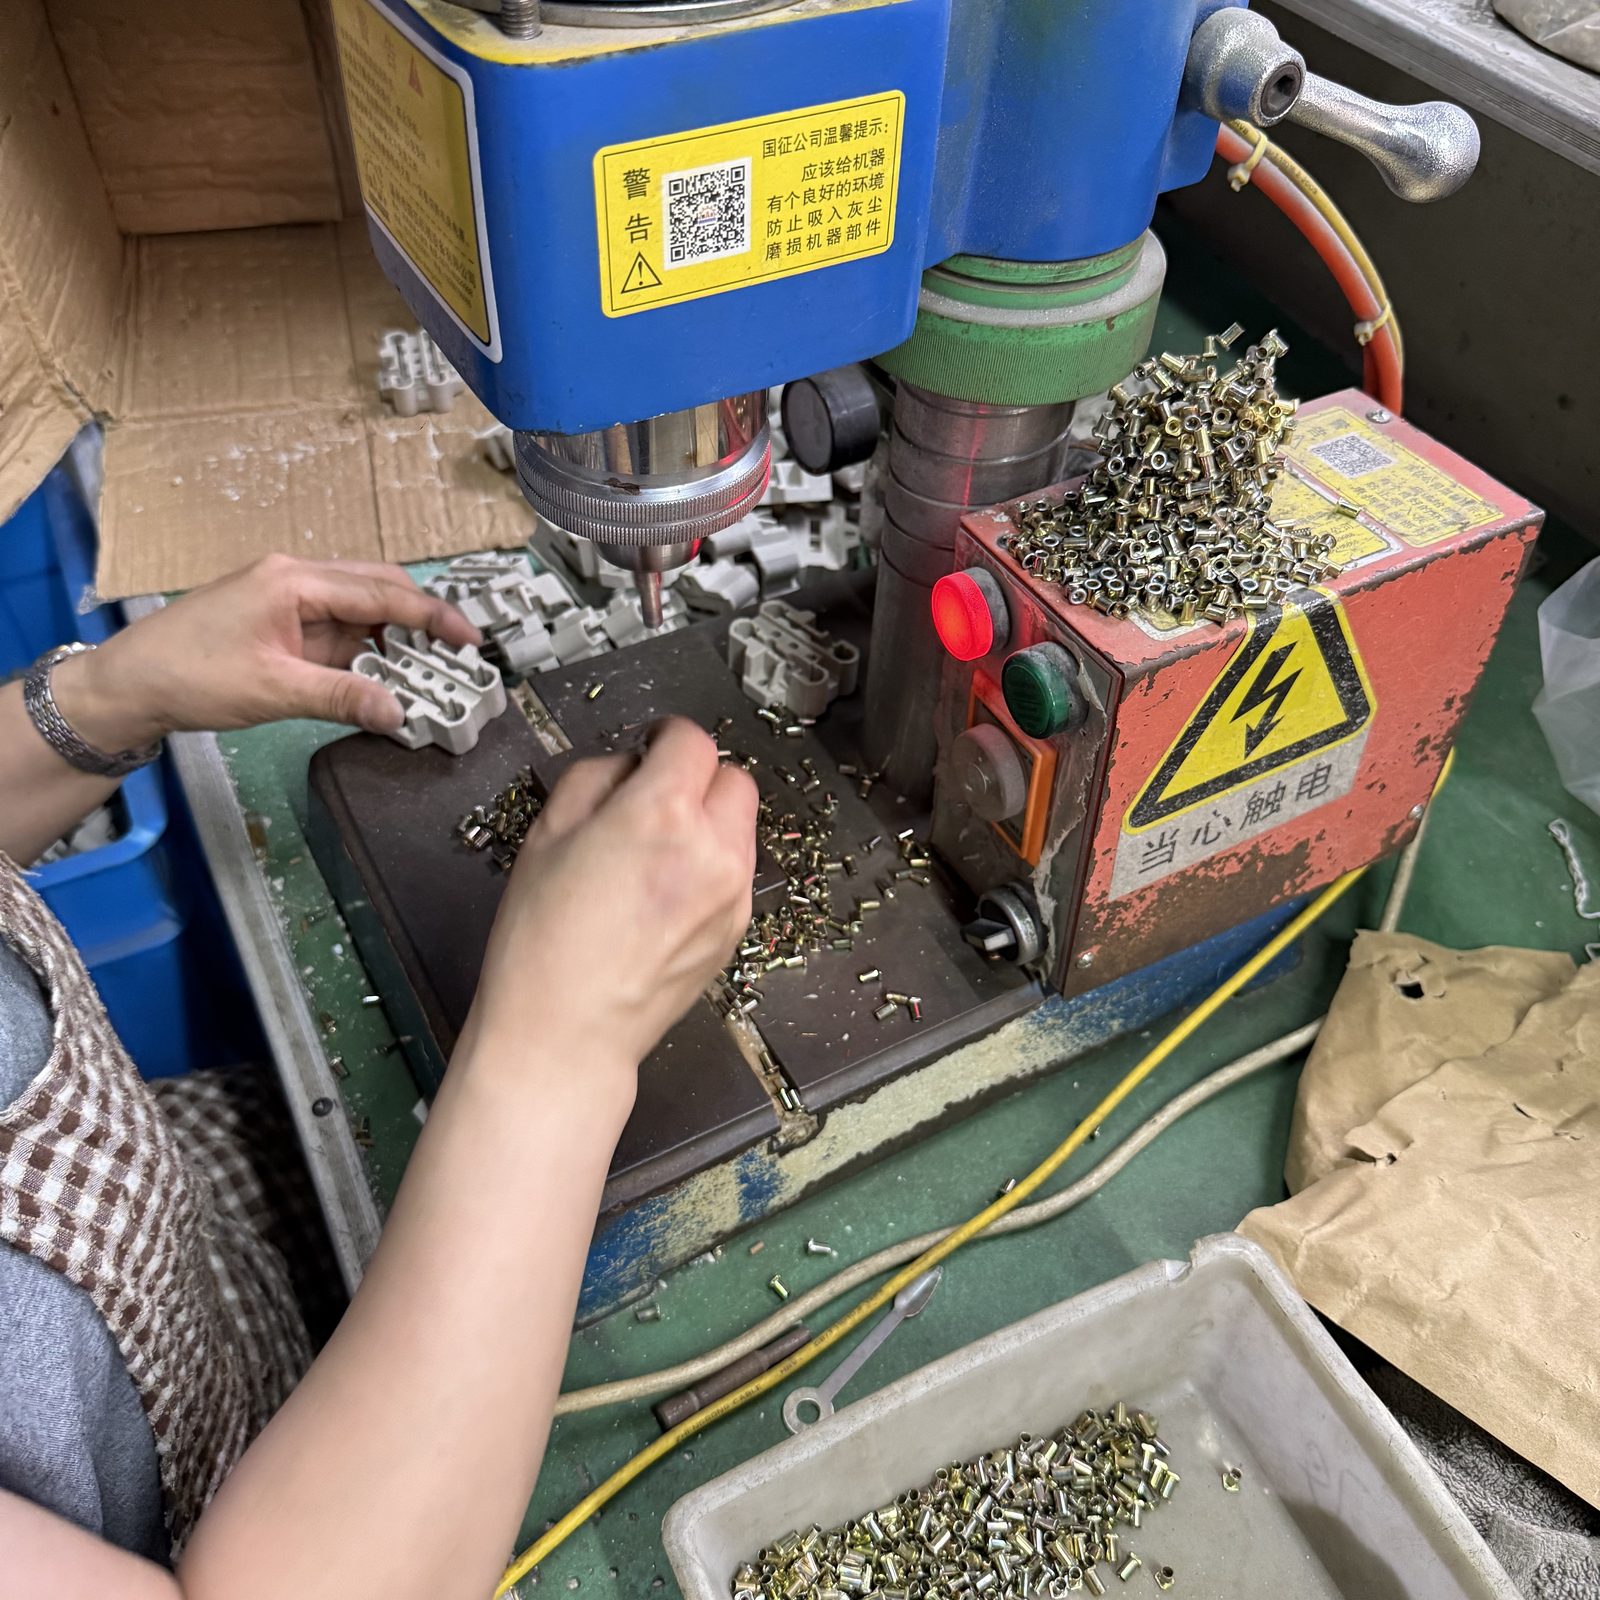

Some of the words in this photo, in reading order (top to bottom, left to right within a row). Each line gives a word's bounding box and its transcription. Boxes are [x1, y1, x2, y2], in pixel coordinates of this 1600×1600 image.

[801, 147, 885, 183] 应该给机器
[623, 167, 653, 244] 警告
[767, 172, 885, 214] 有个良好的环境
[766, 195, 882, 238] 防止吸入灰尘
[765, 218, 881, 261] 磨损机器部件
[1138, 762, 1332, 874] 当心触电
